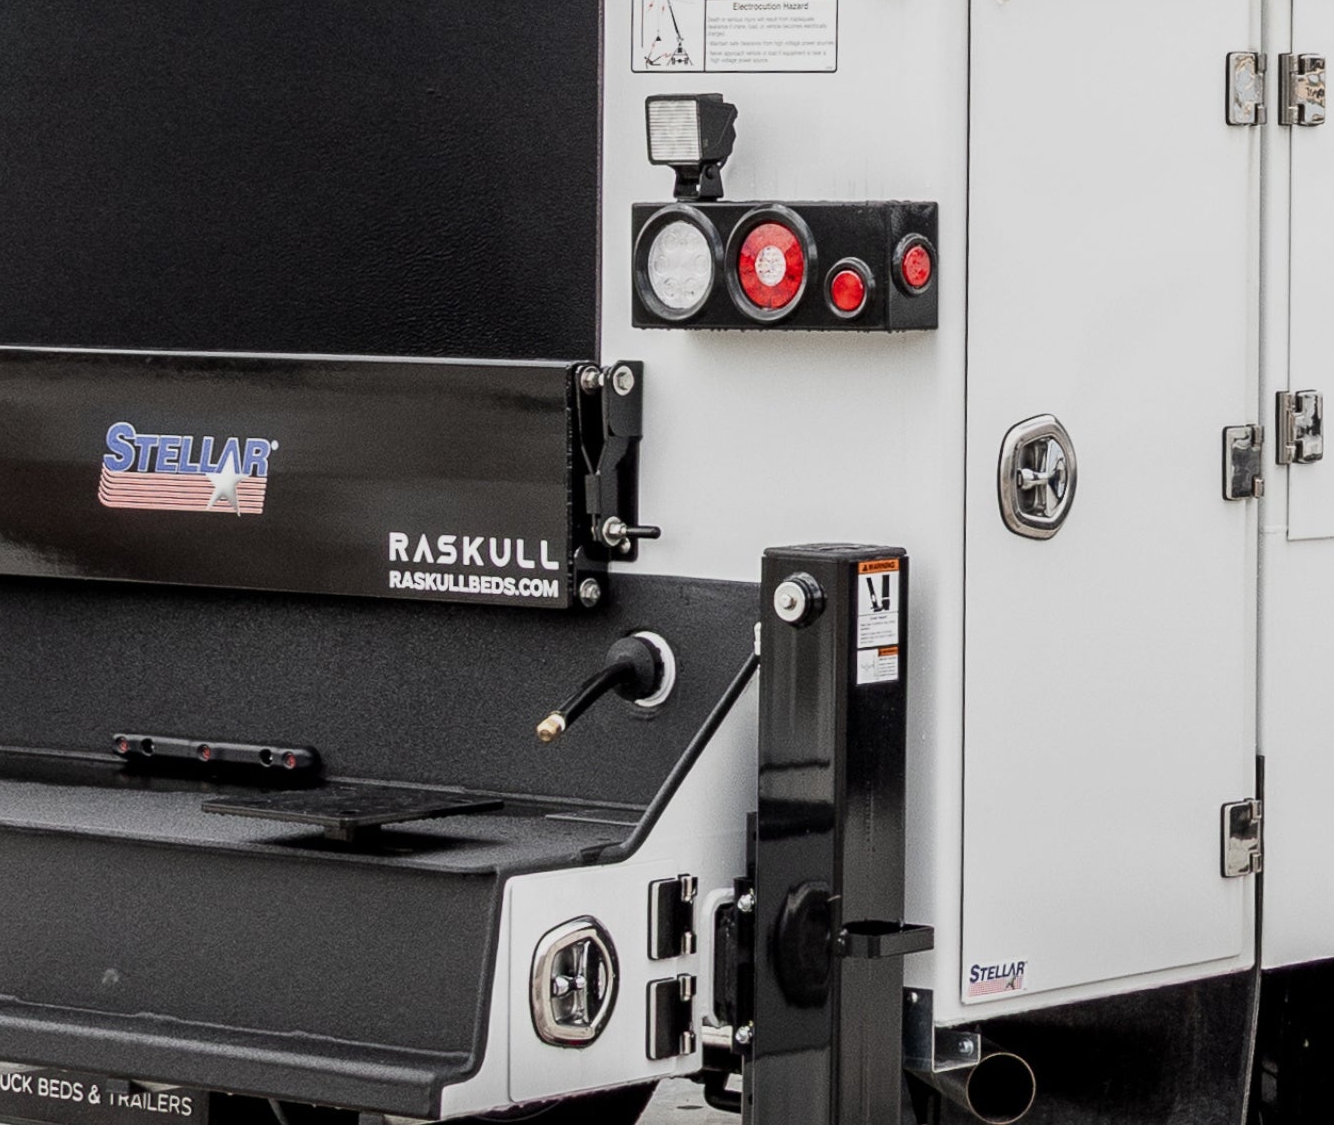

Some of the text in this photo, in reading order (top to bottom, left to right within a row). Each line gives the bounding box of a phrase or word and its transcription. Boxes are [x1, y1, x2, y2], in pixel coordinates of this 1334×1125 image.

[104, 422, 269, 477] STELLAR
[389, 532, 559, 570] RASKULL
[389, 571, 559, 598] RASKULLBEDS.COM
[969, 961, 1025, 984] STELLAR
[38, 1077, 83, 1102] BEDS
[88, 1084, 101, 1104] &
